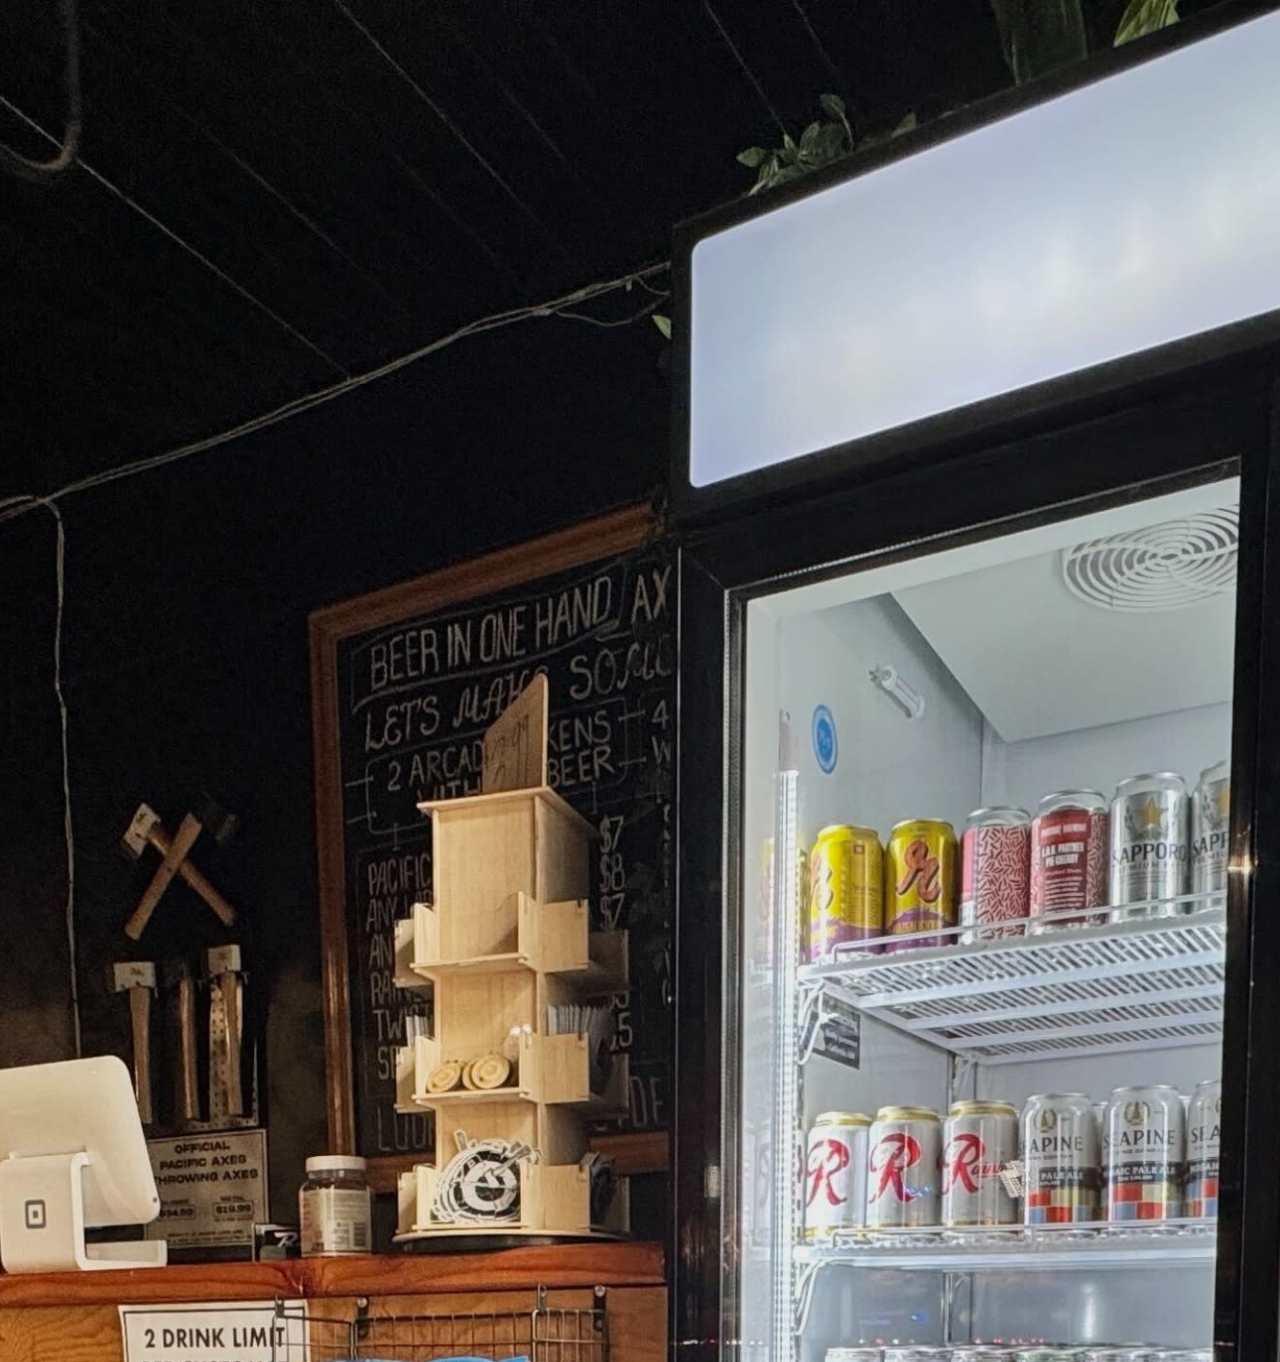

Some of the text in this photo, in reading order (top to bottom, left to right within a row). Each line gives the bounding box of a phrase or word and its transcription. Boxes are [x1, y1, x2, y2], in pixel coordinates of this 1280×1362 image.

[631, 567, 673, 623] AX
[370, 575, 612, 691] BEER IN ONE HAND
[365, 694, 441, 751] LET'S
[387, 761, 402, 792] 2
[409, 740, 485, 788] ARCAD
[547, 746, 616, 789] BEER
[599, 815, 625, 853] $7
[367, 853, 626, 897] PACIFIC $8
[160, 1154, 247, 1170] PACIFIC AXES
[174, 1141, 231, 1154] OFFICIAL
[223, 1168, 259, 1181] AXES
[144, 1327, 286, 1349] 2 DRINK LIMIT
